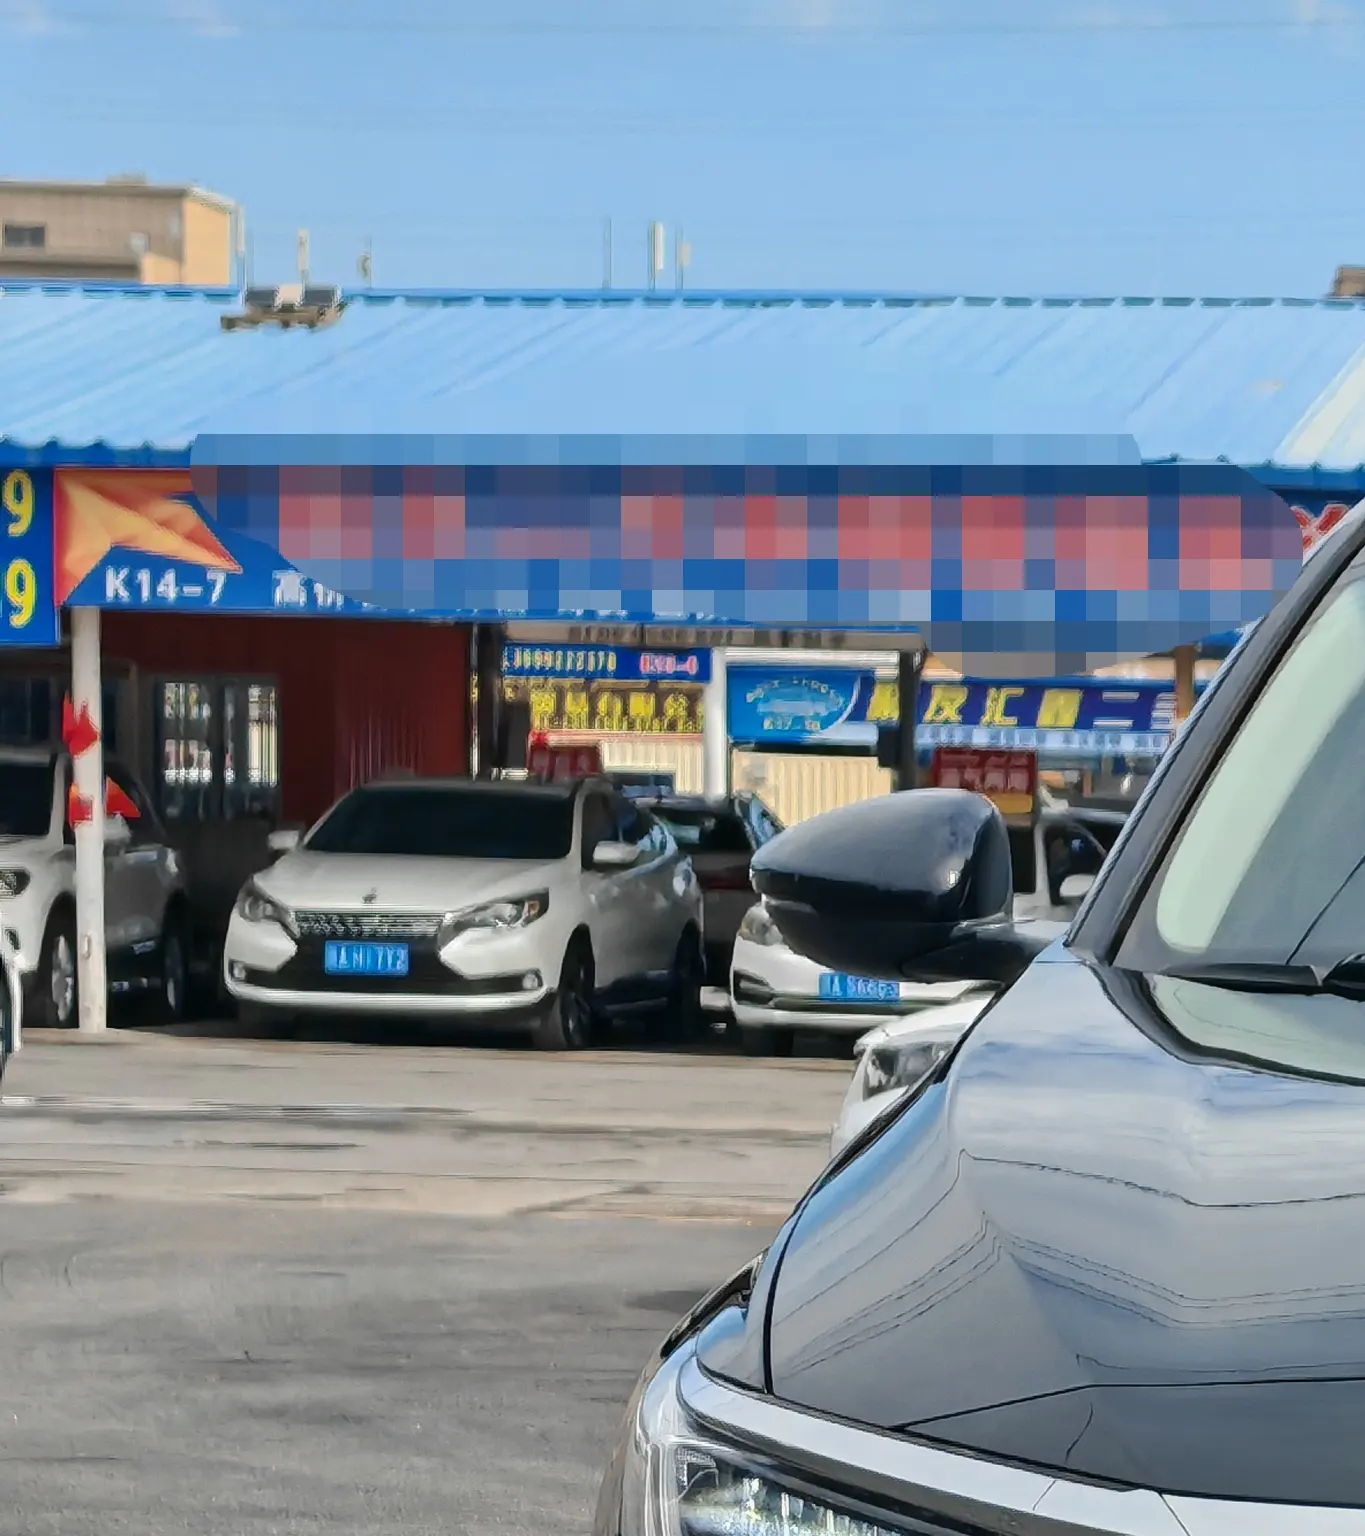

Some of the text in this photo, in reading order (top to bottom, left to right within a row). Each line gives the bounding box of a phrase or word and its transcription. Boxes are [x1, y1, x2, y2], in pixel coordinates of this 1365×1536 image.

[4, 469, 33, 537] 9
[6, 559, 37, 629] 9
[104, 566, 227, 604] K14-7
